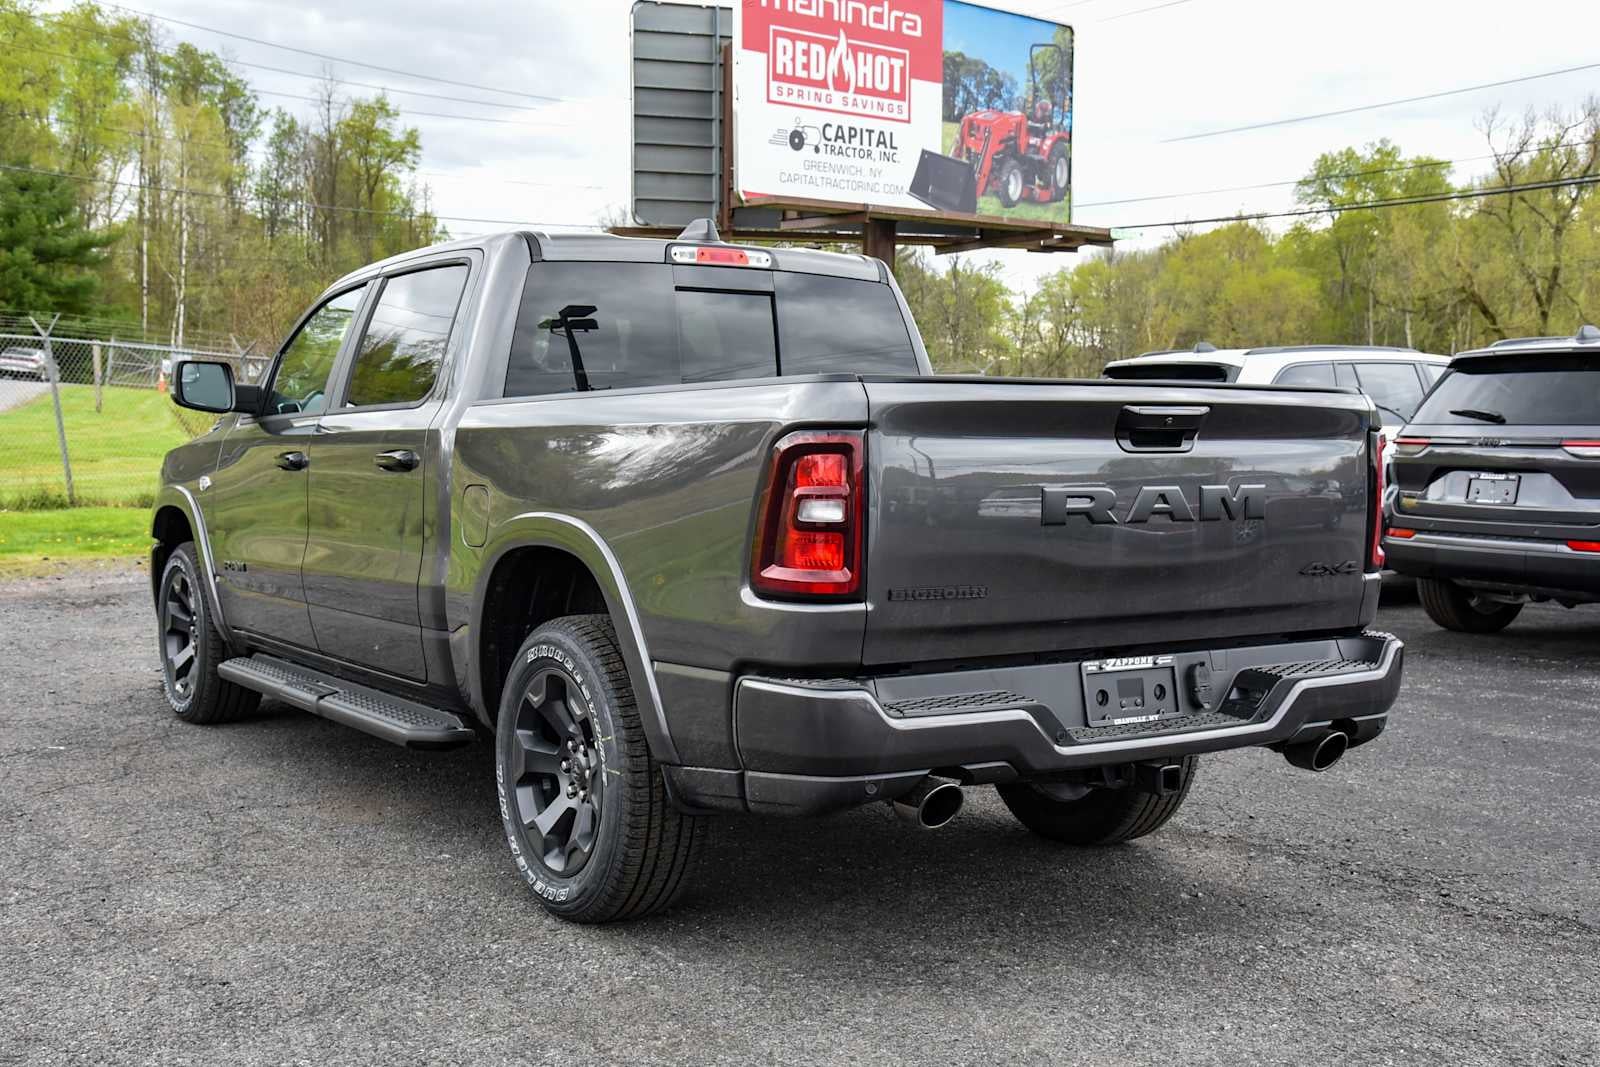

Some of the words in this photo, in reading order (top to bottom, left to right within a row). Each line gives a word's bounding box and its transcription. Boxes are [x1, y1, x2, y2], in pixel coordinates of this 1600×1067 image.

[776, 36, 825, 80] RED
[857, 51, 904, 93] HOT
[776, 86, 833, 104] SPRING
[841, 96, 904, 115] SAVINGS
[822, 123, 898, 150] CAPITAL
[823, 144, 876, 162] TRACTOR,
[879, 151, 901, 163] INC.
[869, 167, 883, 179] NY
[1040, 484, 1267, 526] RAM
[1106, 656, 1154, 670] ZAPPONE
